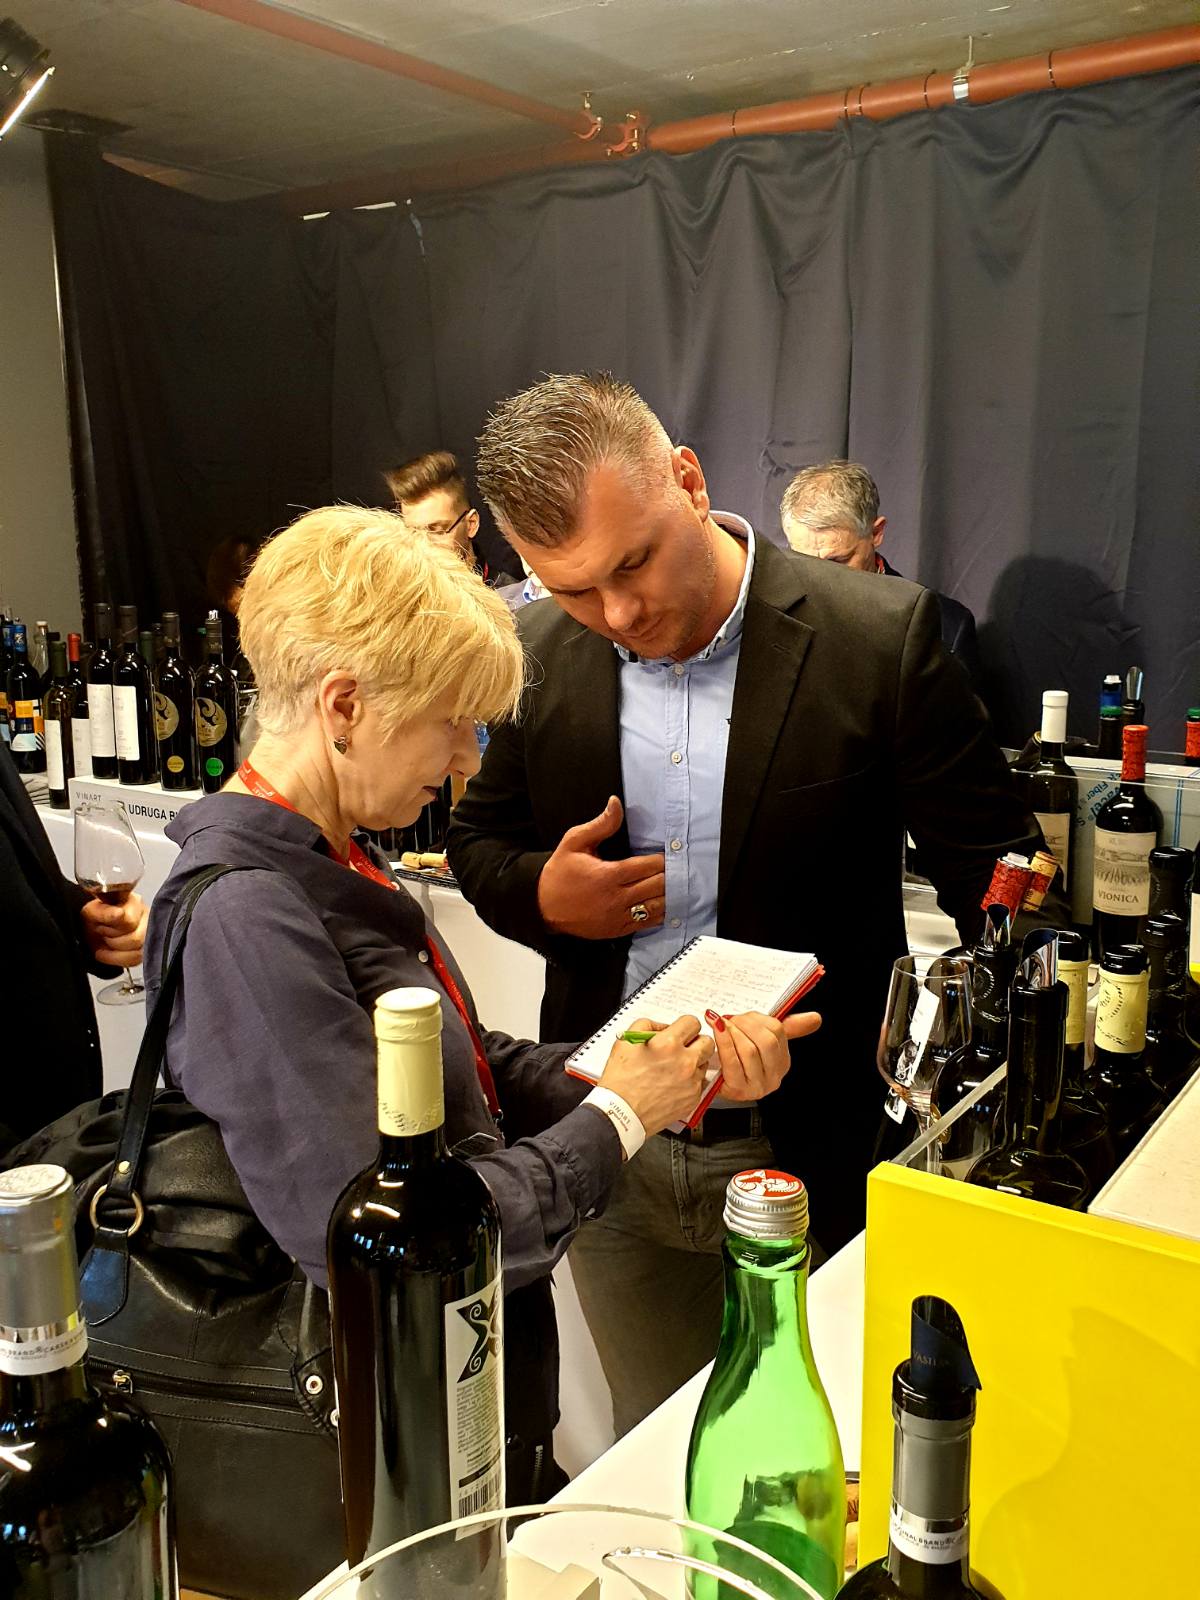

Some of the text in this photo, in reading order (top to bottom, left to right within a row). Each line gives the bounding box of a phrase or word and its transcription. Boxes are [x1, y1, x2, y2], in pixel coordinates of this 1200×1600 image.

[76, 792, 102, 801] VINART
[128, 804, 178, 821] UDRUGA B
[1098, 889, 1139, 903] VIONICA
